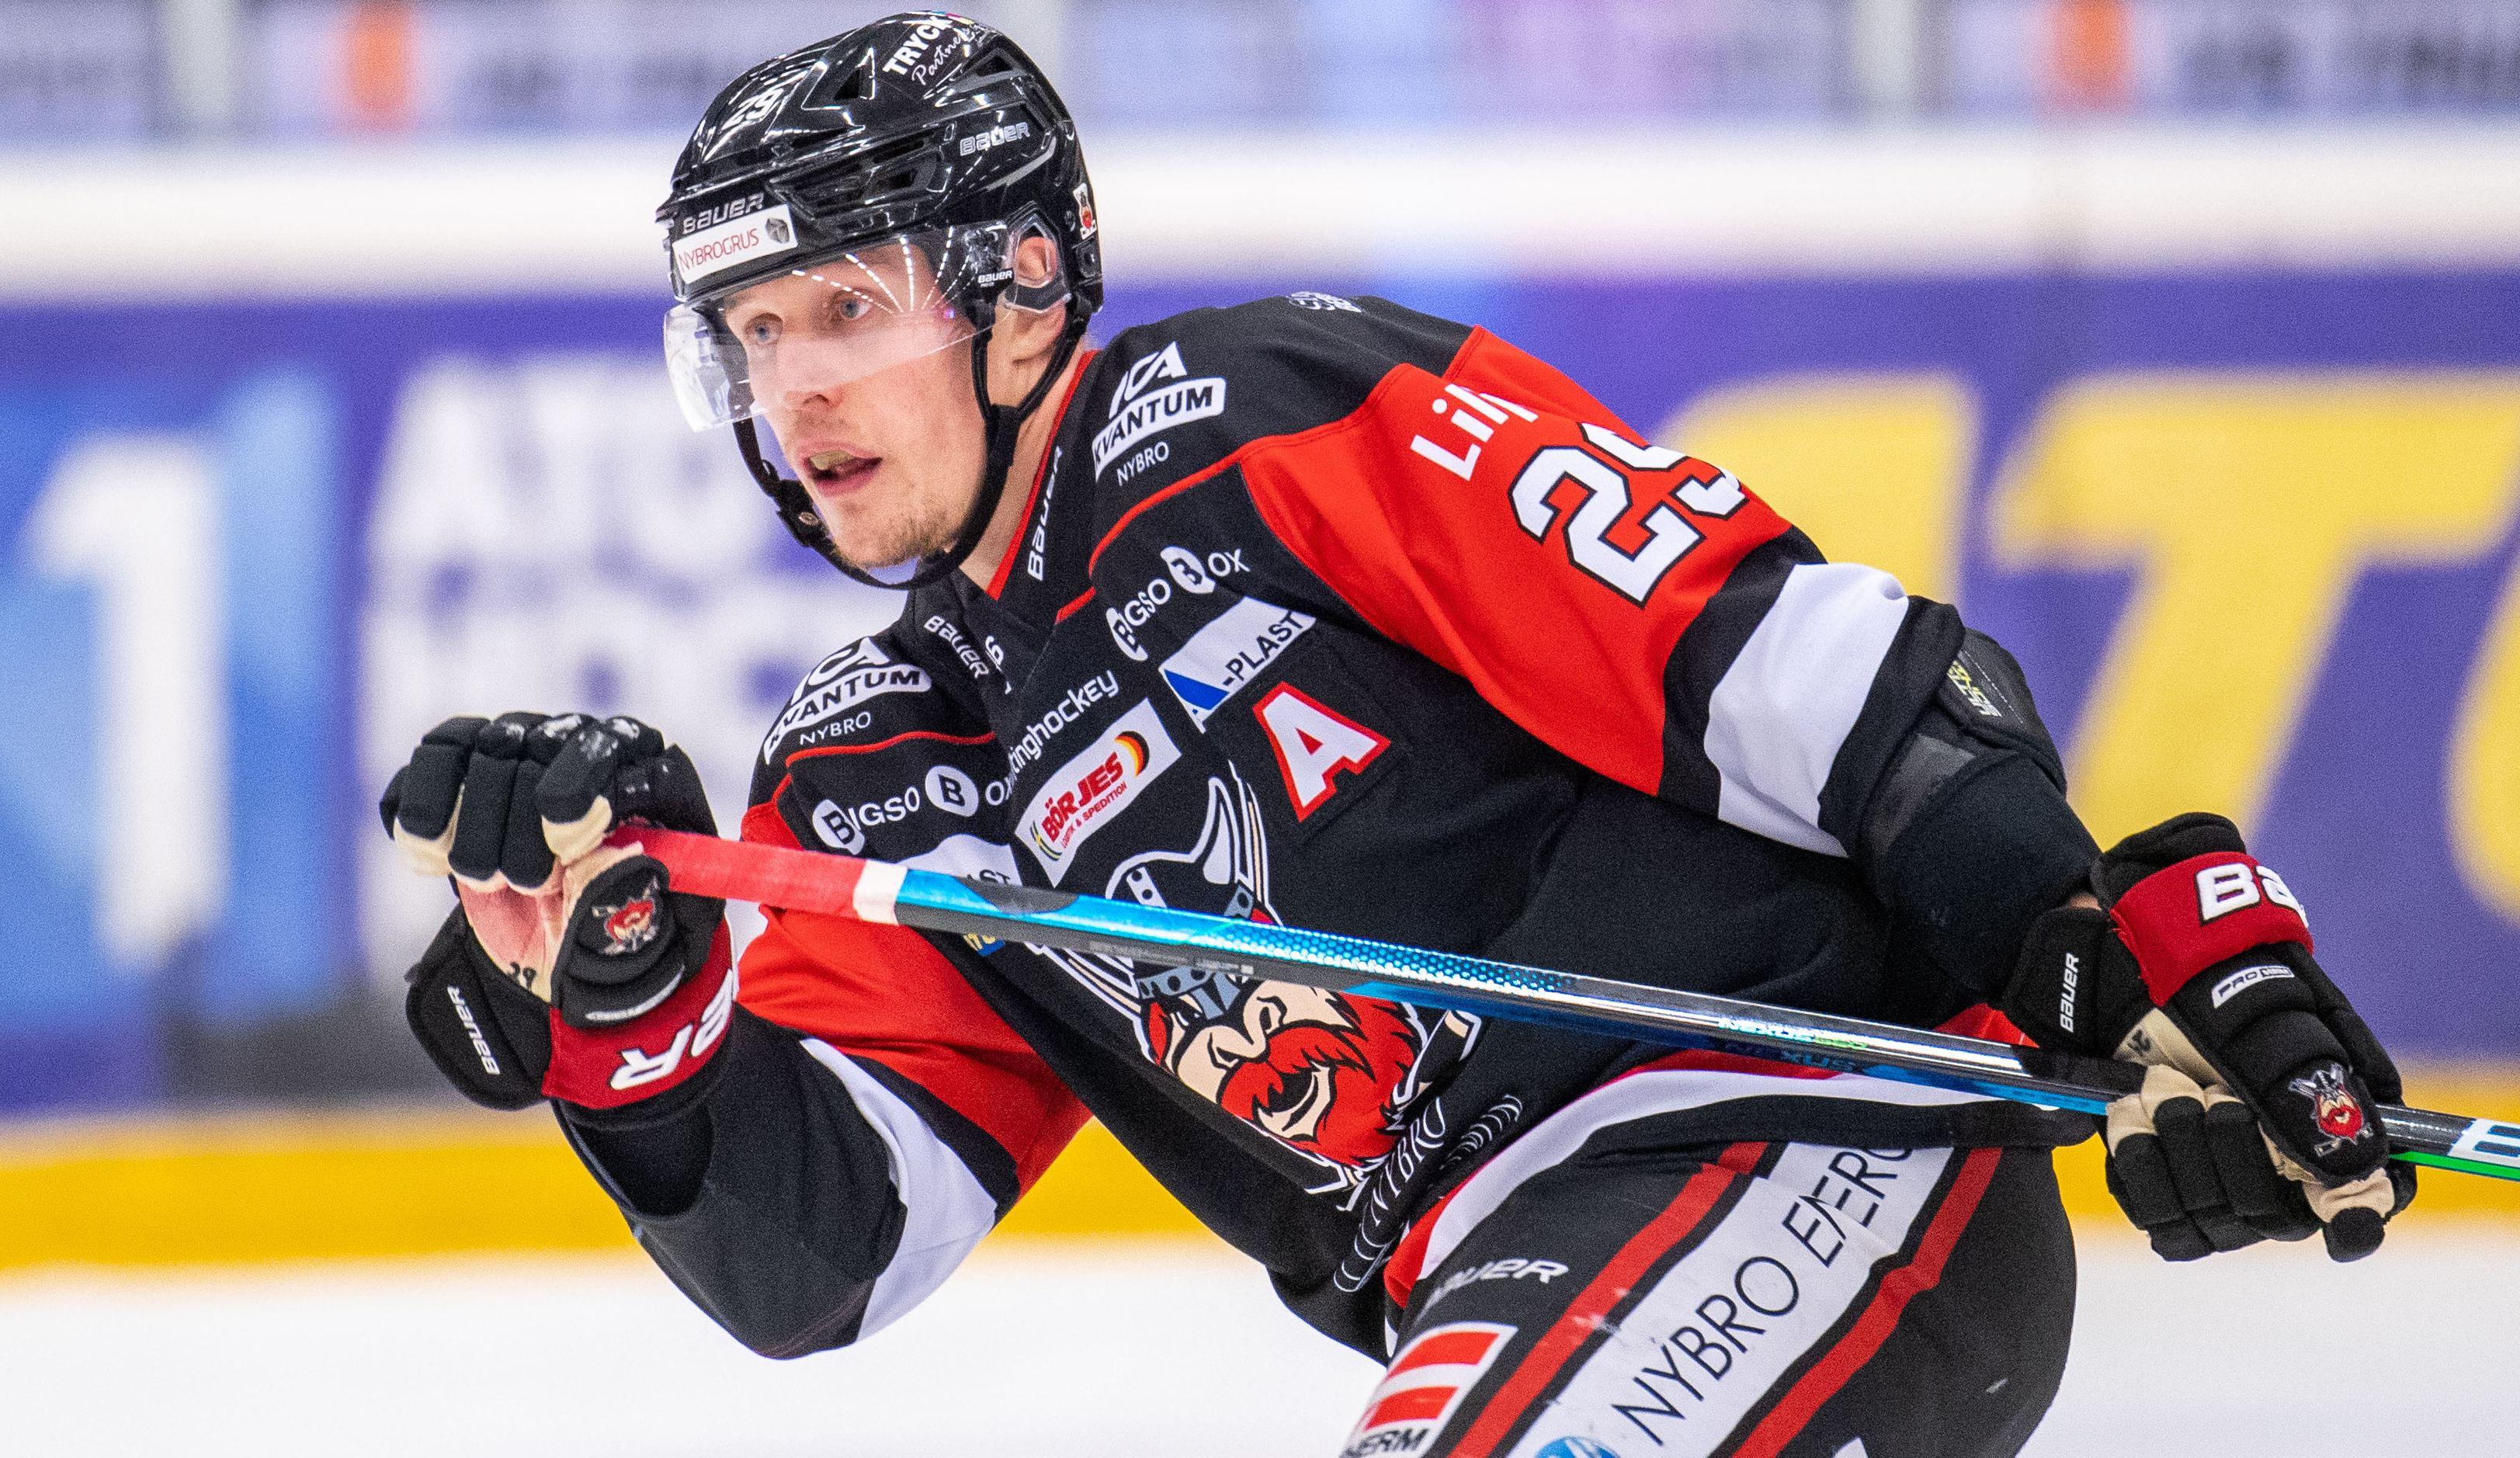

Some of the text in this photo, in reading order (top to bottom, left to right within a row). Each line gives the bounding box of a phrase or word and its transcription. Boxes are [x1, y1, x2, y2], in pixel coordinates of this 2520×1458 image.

[883, 16, 953, 75] TRYCK
[721, 87, 784, 130] 29
[960, 122, 1030, 156] BAUER
[682, 193, 765, 234] BAUER
[679, 227, 760, 271] NYBROGRUS
[977, 271, 1013, 284] BAUER
[1116, 440, 1170, 487] NYBRO
[1027, 445, 1062, 581] BAUER
[924, 615, 988, 678] BAUER
[800, 711, 872, 746] NYBRO
[1253, 680, 1390, 822] A
[812, 786, 921, 855] BIGSO
[1041, 751, 1123, 843] BÖRJES
[1081, 781, 1127, 821] SPEDITION
[2060, 952, 2080, 1034] BAUER
[447, 986, 501, 1075] BAUER
[1610, 1255, 1800, 1447] NYBRO
